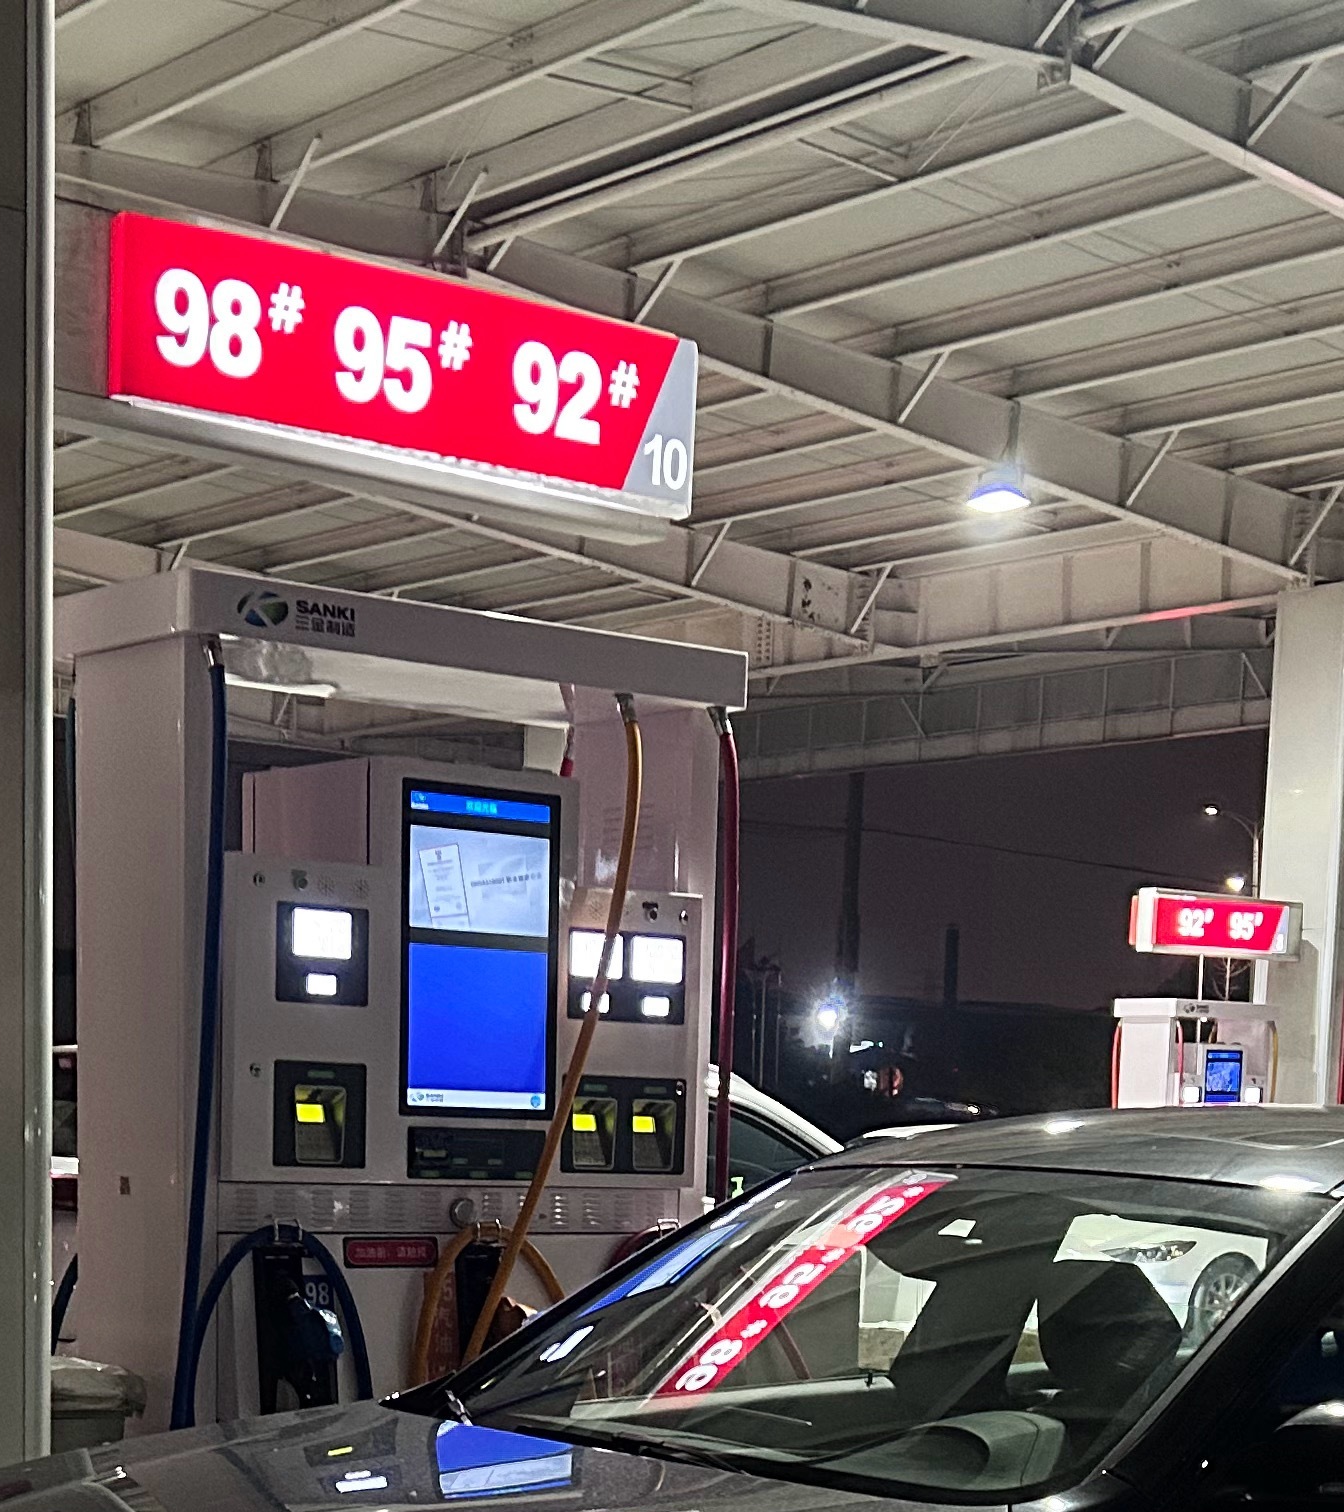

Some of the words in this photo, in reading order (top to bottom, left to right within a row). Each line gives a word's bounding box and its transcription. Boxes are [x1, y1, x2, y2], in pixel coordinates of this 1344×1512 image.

[155, 268, 307, 378] 98#
[333, 305, 474, 413] 95#
[511, 340, 641, 445] 92#
[643, 433, 689, 491] 10
[295, 599, 356, 622] SANKI
[305, 1281, 331, 1308] 98
